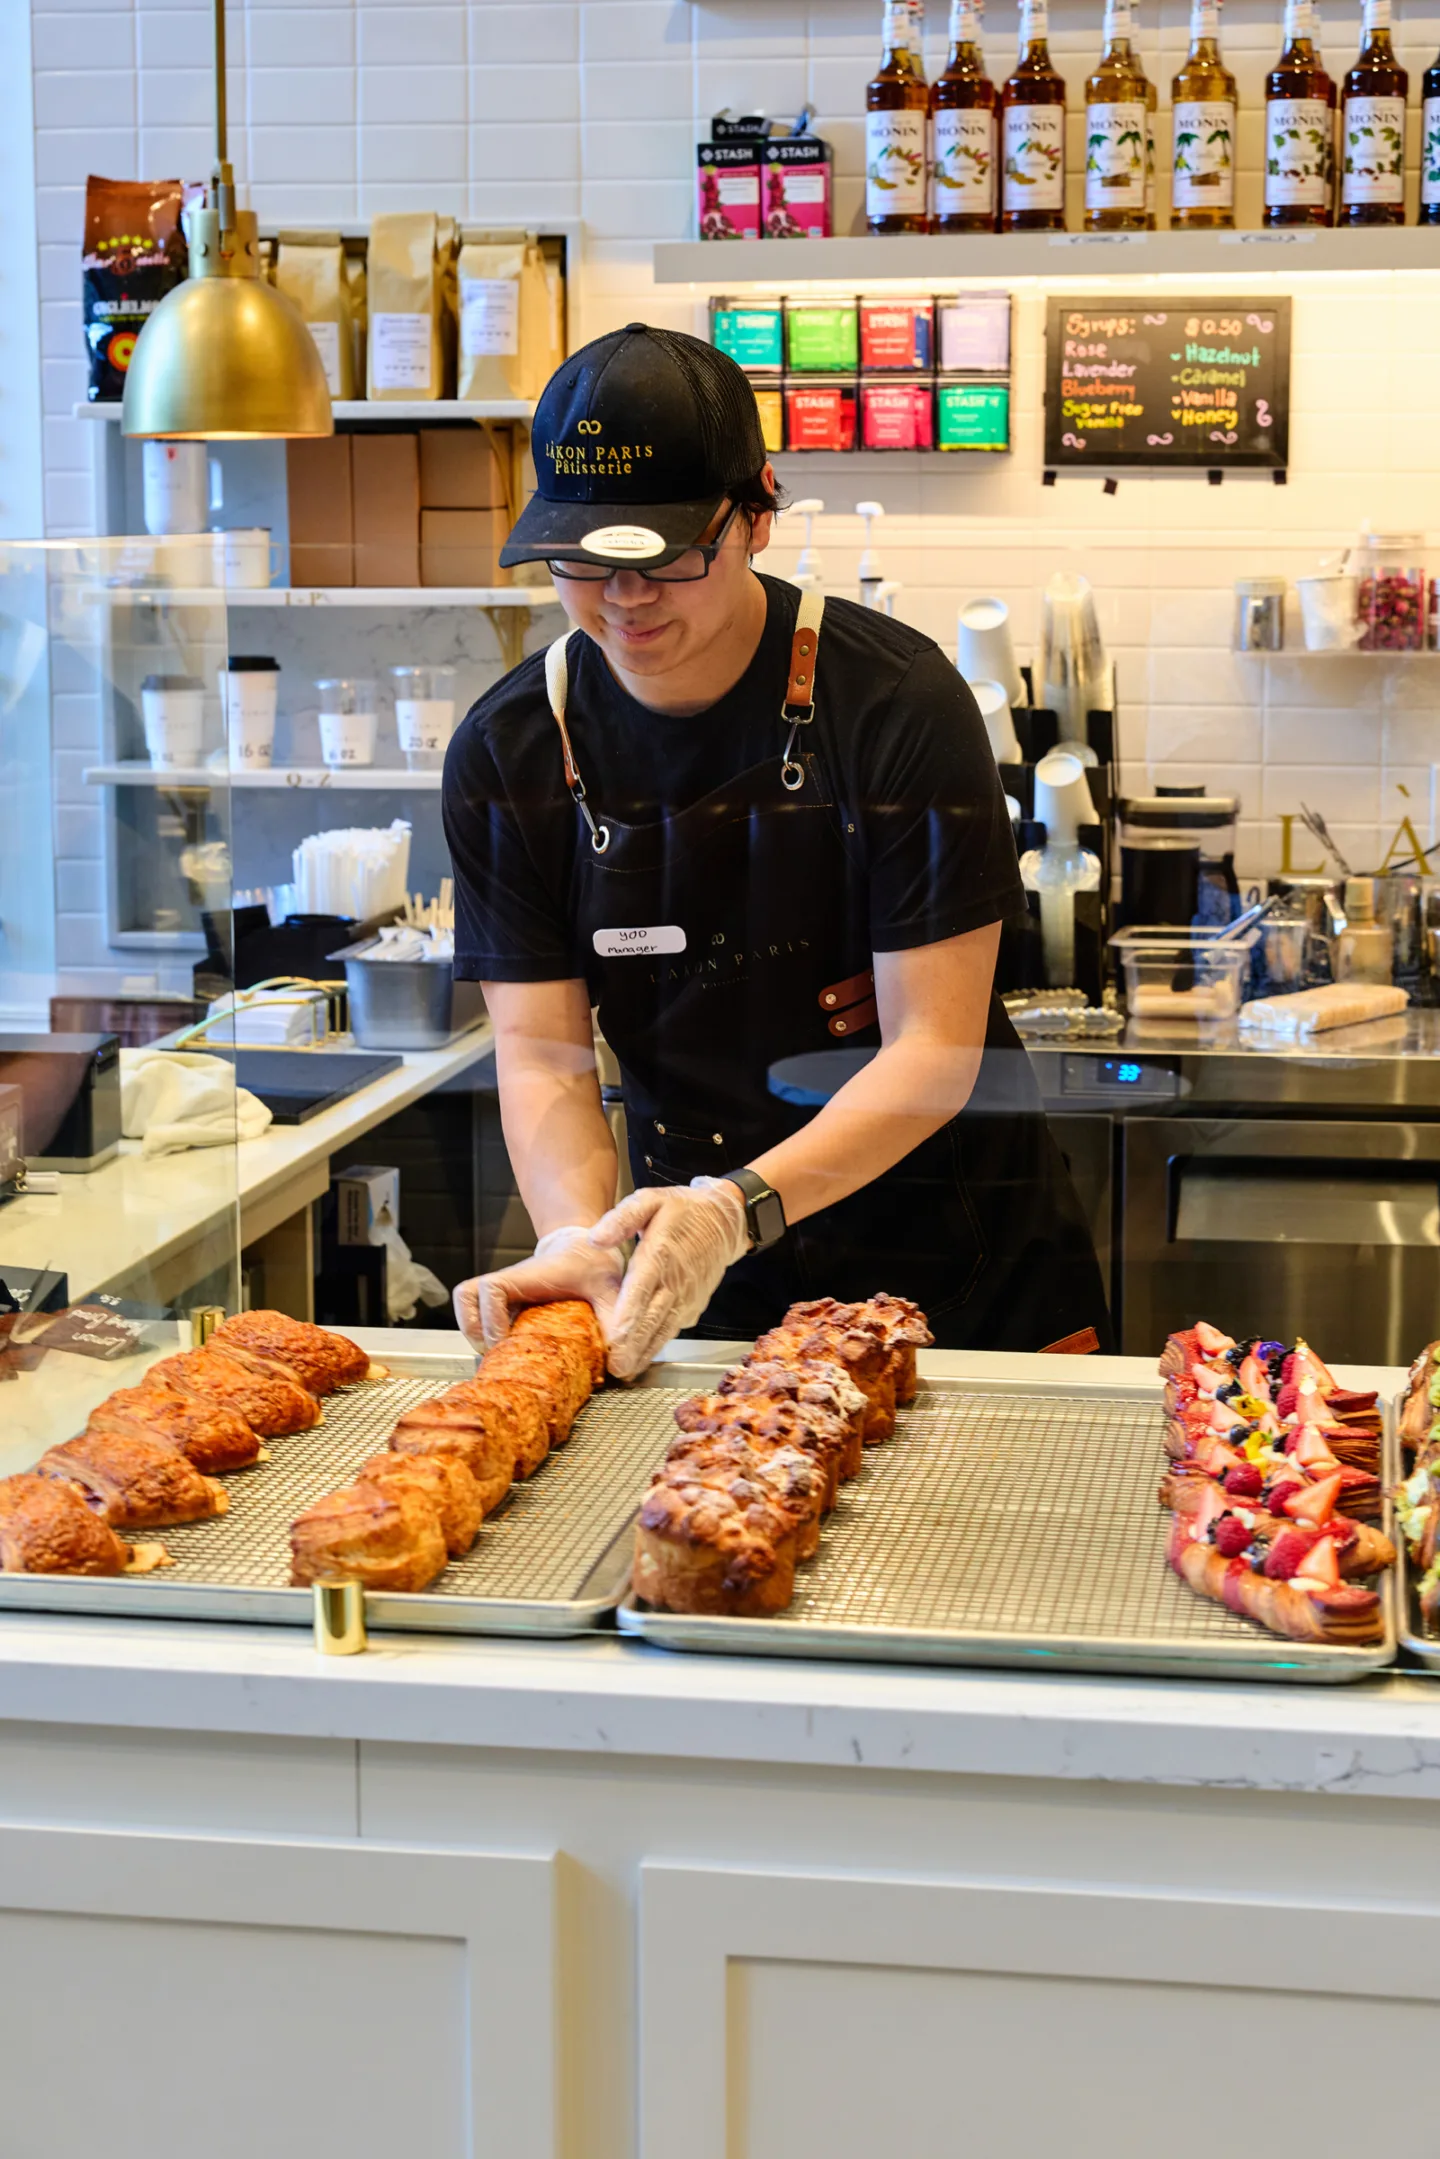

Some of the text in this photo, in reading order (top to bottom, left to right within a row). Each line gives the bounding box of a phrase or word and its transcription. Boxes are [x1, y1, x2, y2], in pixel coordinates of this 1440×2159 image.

[1090, 120, 1139, 129] MONIN
[1179, 118, 1228, 129] MONIN
[1274, 116, 1323, 126] MONIN
[1349, 114, 1399, 124] MONIN
[871, 127, 919, 138] MONIN
[937, 126, 986, 136] MONIN
[1008, 122, 1057, 132] MONIN
[715, 149, 754, 160] STASH
[780, 147, 819, 158] STASH
[1066, 313, 1136, 338] Syrups:
[1064, 341, 1107, 358] Rose
[1185, 343, 1261, 367] Hazelnut
[1062, 361, 1137, 378] Lavender
[1180, 368, 1246, 387] Caramel
[1061, 379, 1136, 401] Blueberry
[796, 397, 835, 408] STASH
[870, 397, 909, 408] STASH
[946, 396, 986, 407] STASH
[1062, 400, 1107, 418] Sugar
[1182, 409, 1238, 430] Honey
[596, 445, 653, 460] PARIS
[555, 460, 632, 475] Pâtisserie
[734, 938, 809, 965] PARIS
